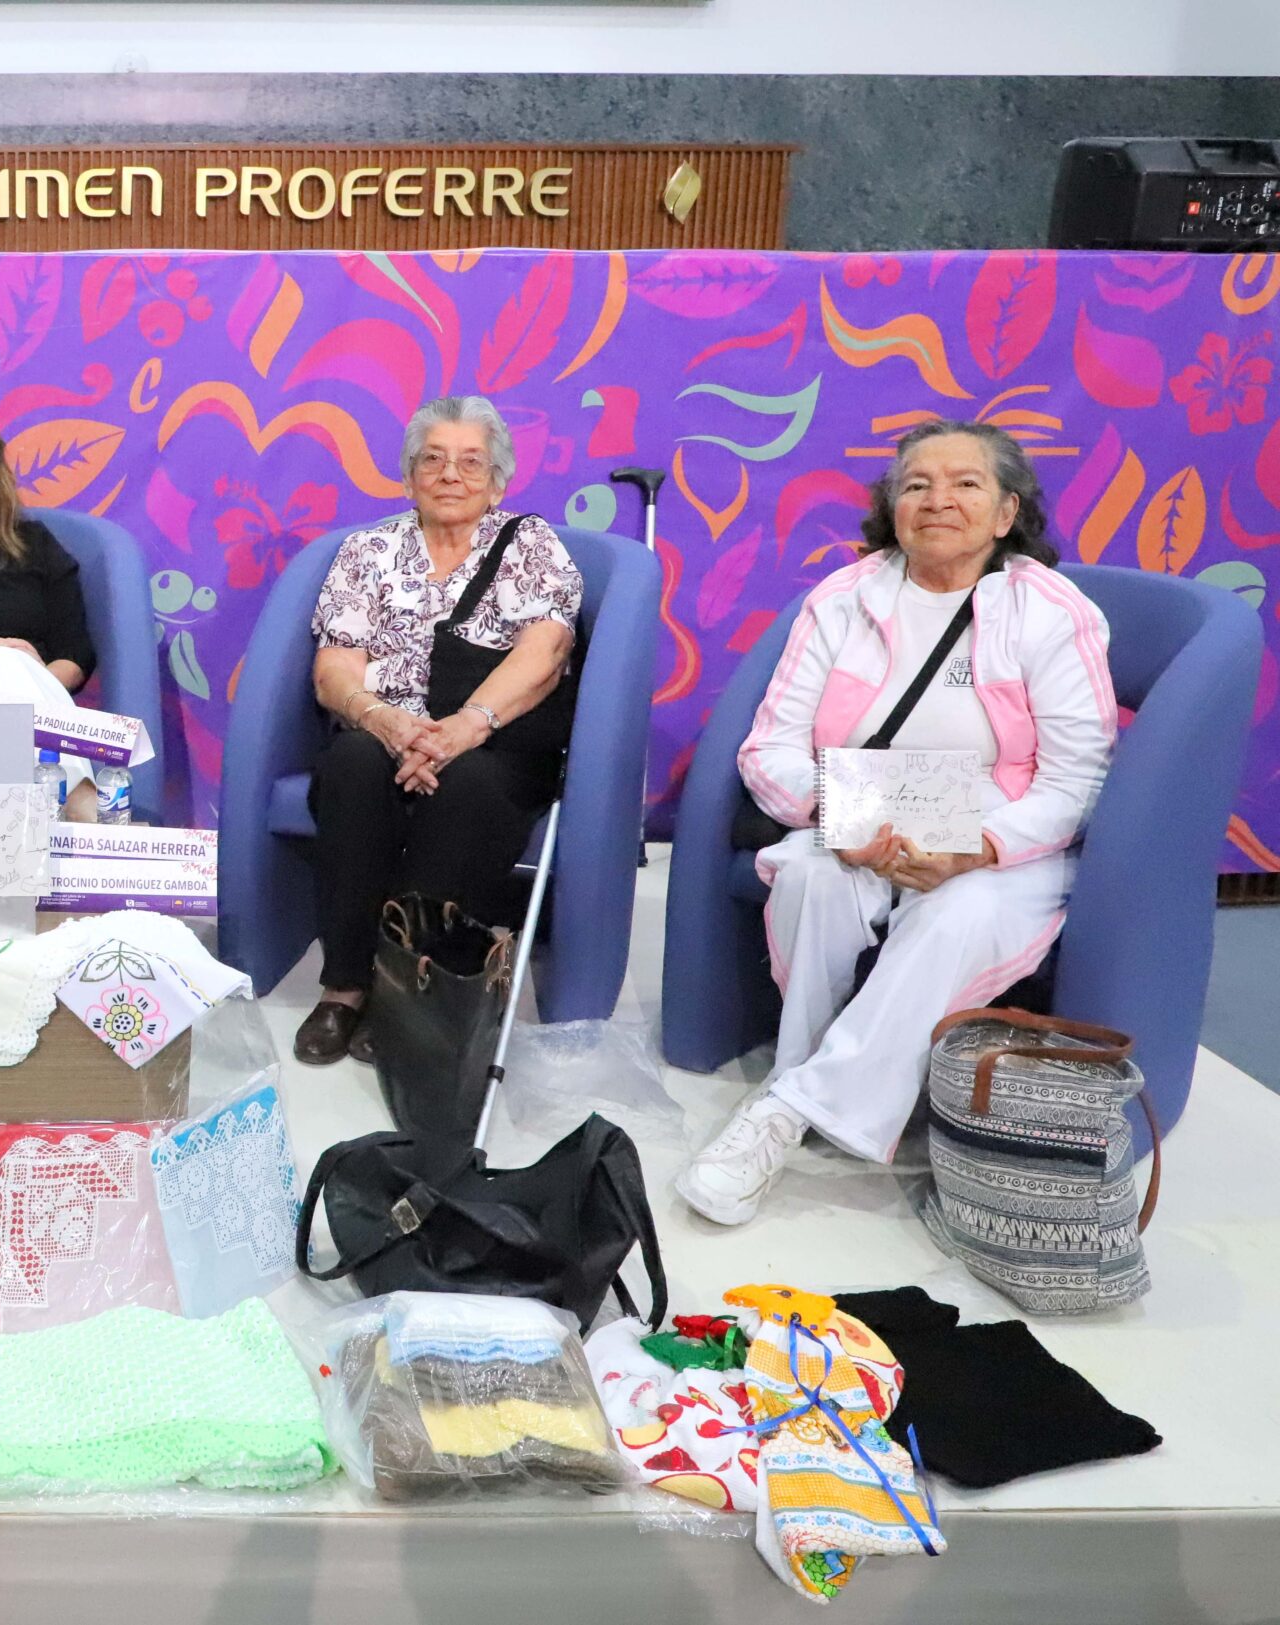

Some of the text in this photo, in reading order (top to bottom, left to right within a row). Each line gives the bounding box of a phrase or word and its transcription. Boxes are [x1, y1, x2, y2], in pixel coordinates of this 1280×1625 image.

[196, 166, 573, 220] PROFERRE
[44, 717, 75, 734] PADILLA
[76, 724, 89, 736] DE
[89, 726, 99, 738] LA
[100, 728, 127, 745] TORRE
[97, 838, 148, 854] SALAZAR
[151, 842, 207, 858] HERRERA
[50, 876, 208, 891] TROCINIO DOMÍNGUEZ GAMBOA
